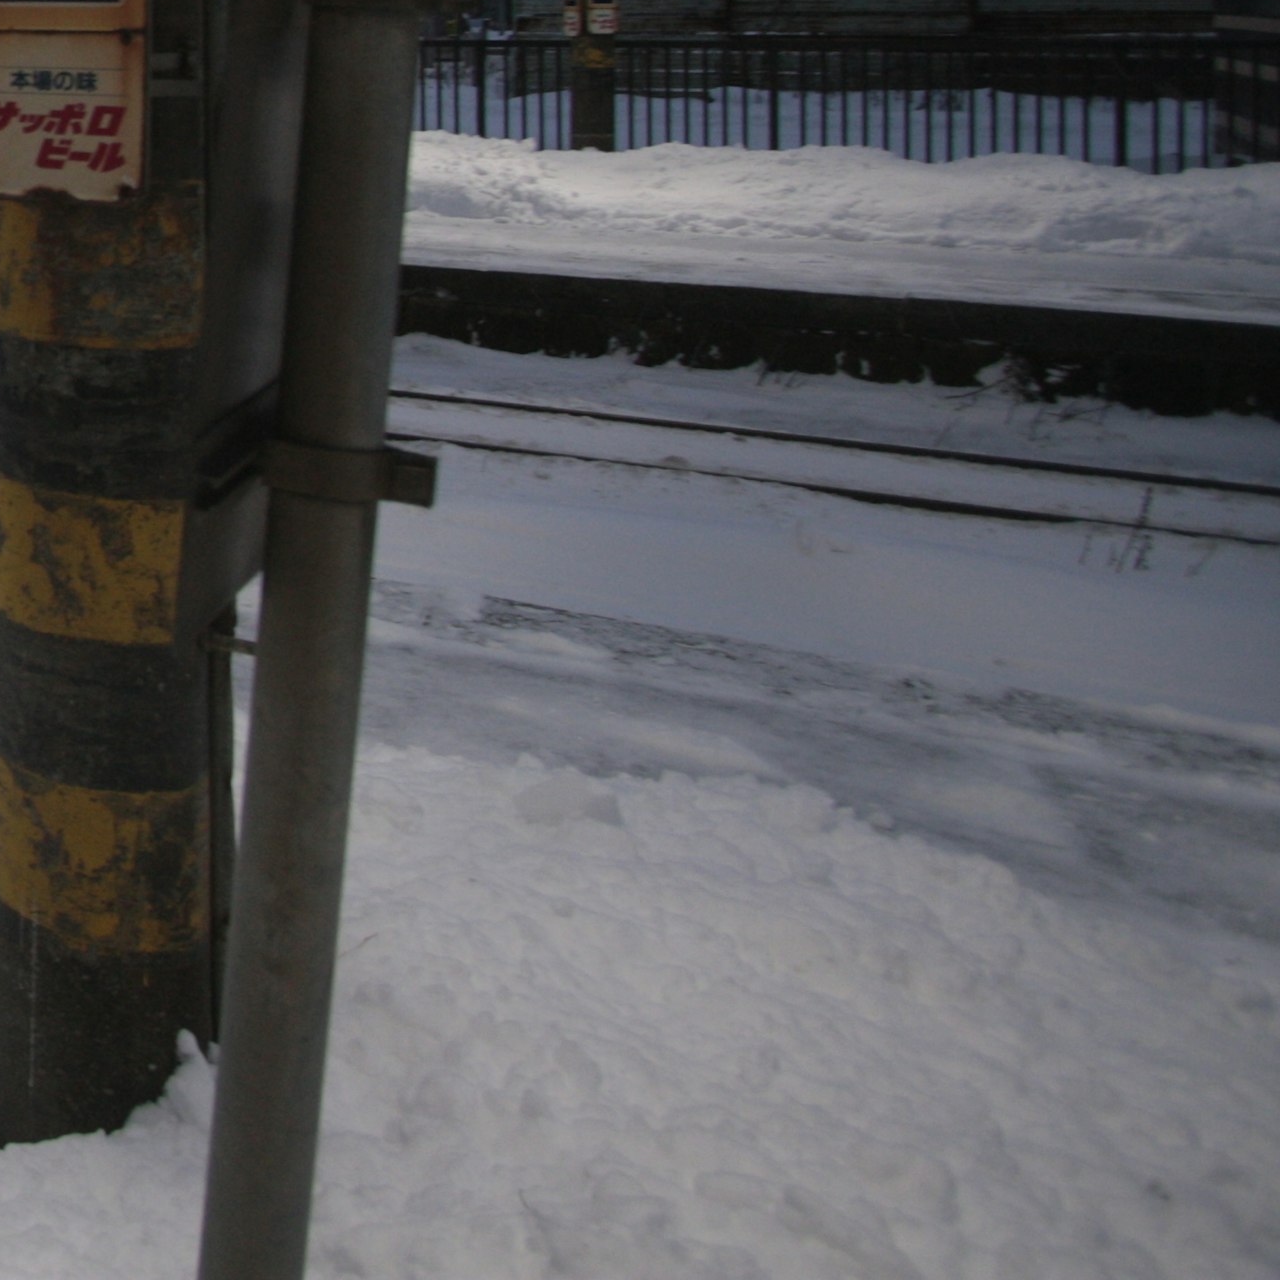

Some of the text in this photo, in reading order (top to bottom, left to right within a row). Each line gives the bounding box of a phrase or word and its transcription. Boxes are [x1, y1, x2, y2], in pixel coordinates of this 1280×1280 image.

[11, 70, 98, 91] 本場の味
[36, 138, 126, 173] ビール
